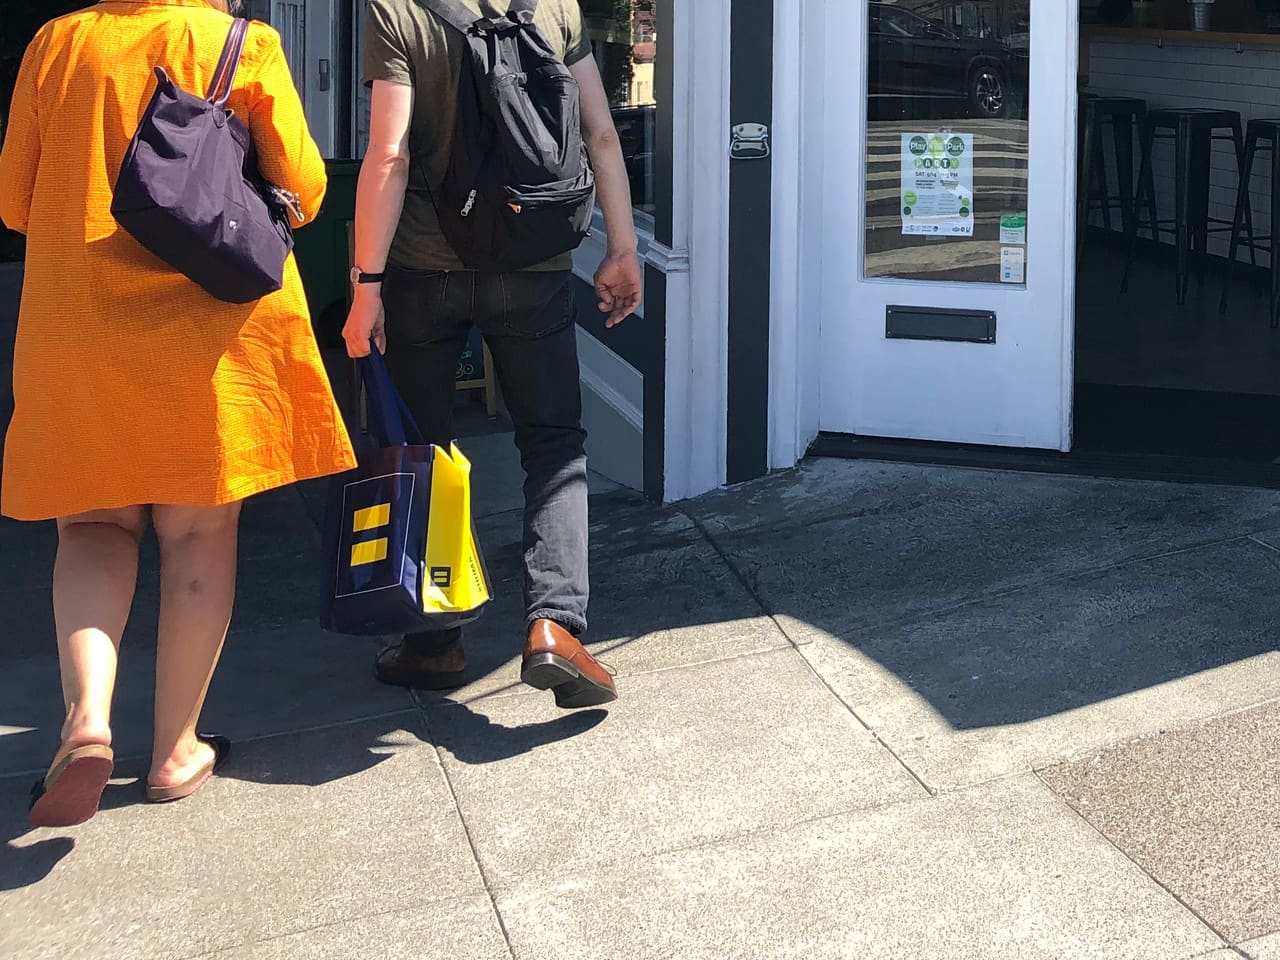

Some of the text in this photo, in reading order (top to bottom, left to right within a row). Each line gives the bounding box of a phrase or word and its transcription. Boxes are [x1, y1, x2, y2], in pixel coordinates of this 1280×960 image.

[910, 142, 926, 151] Play
[947, 142, 965, 150] Park
[915, 159, 958, 168] PARTY
